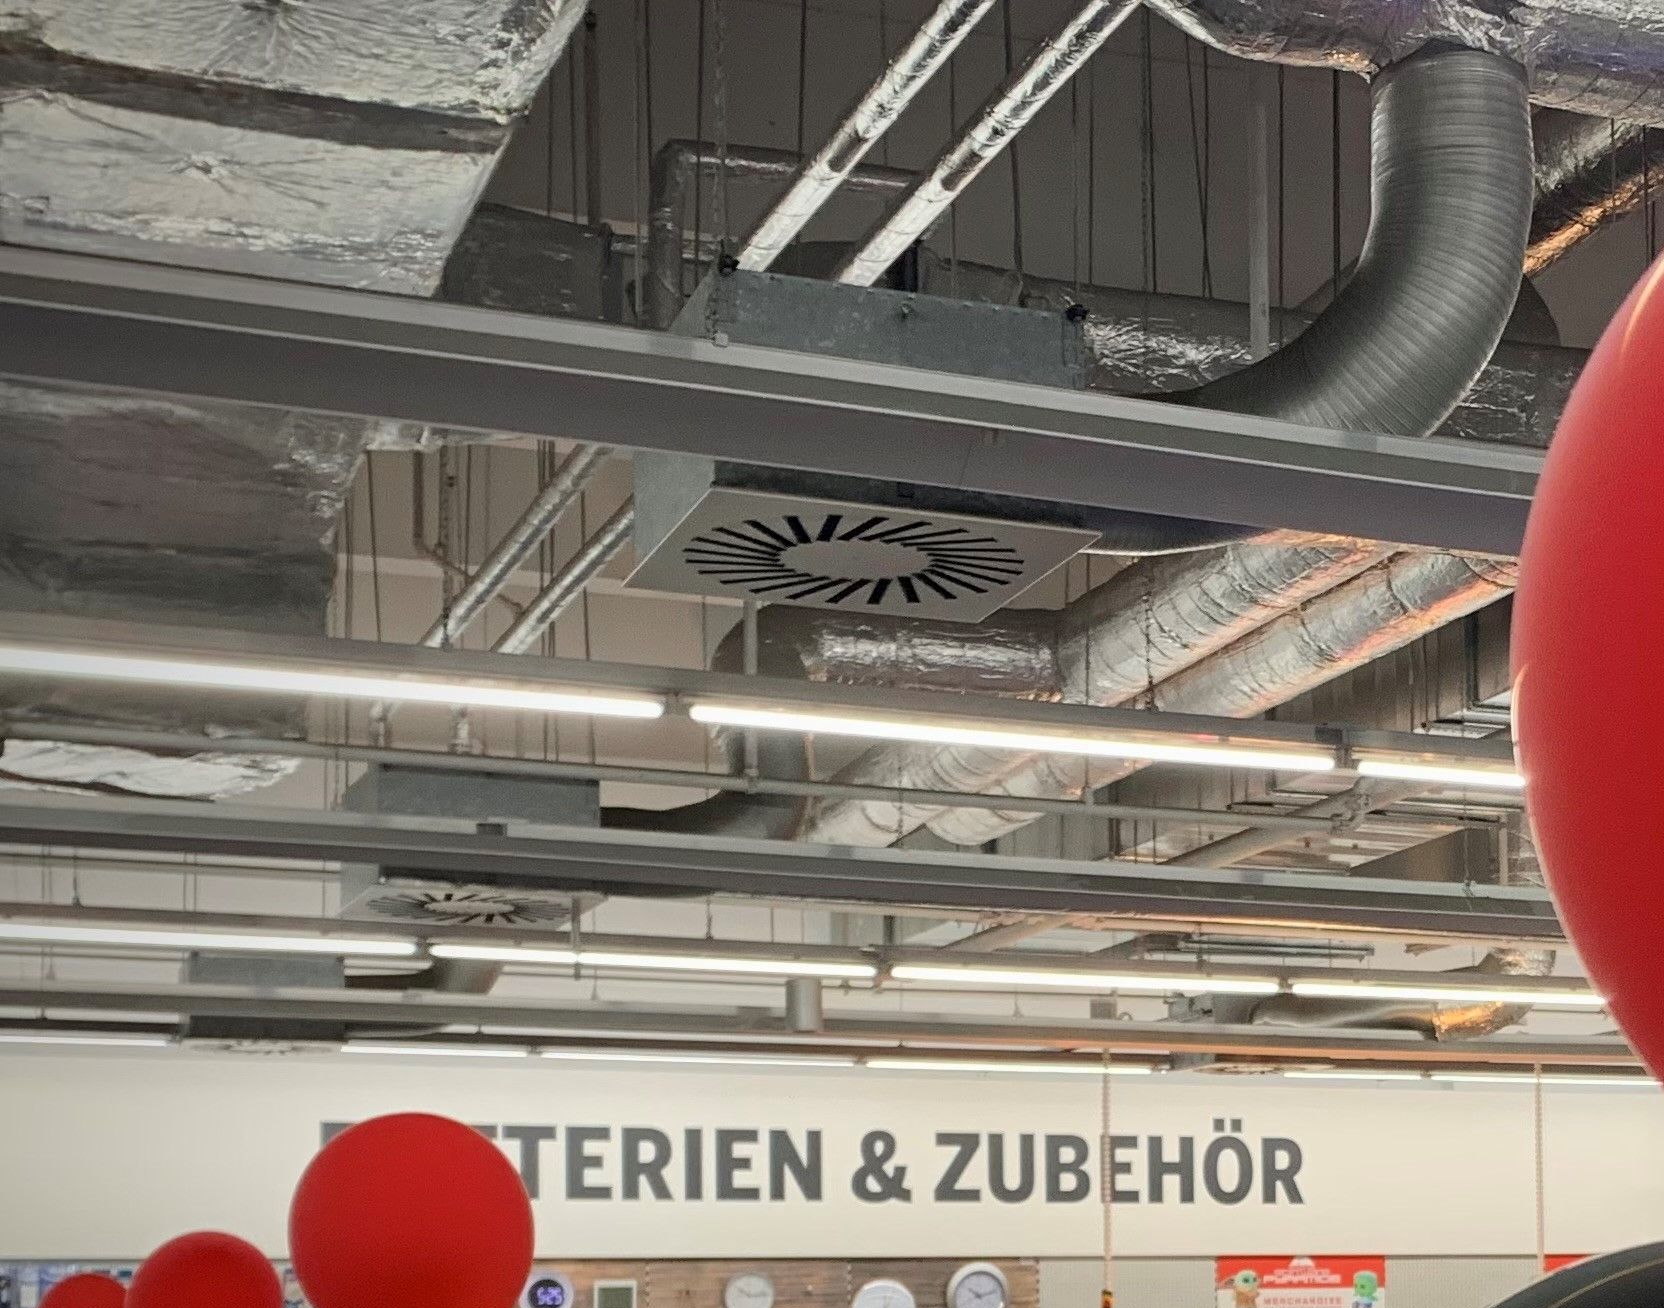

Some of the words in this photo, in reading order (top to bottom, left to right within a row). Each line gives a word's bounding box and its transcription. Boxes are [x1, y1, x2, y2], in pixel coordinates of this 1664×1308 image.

[320, 1121, 823, 1203] TERIEN
[851, 1129, 913, 1204] &
[933, 1117, 1306, 1205] ZUBEHÖR
